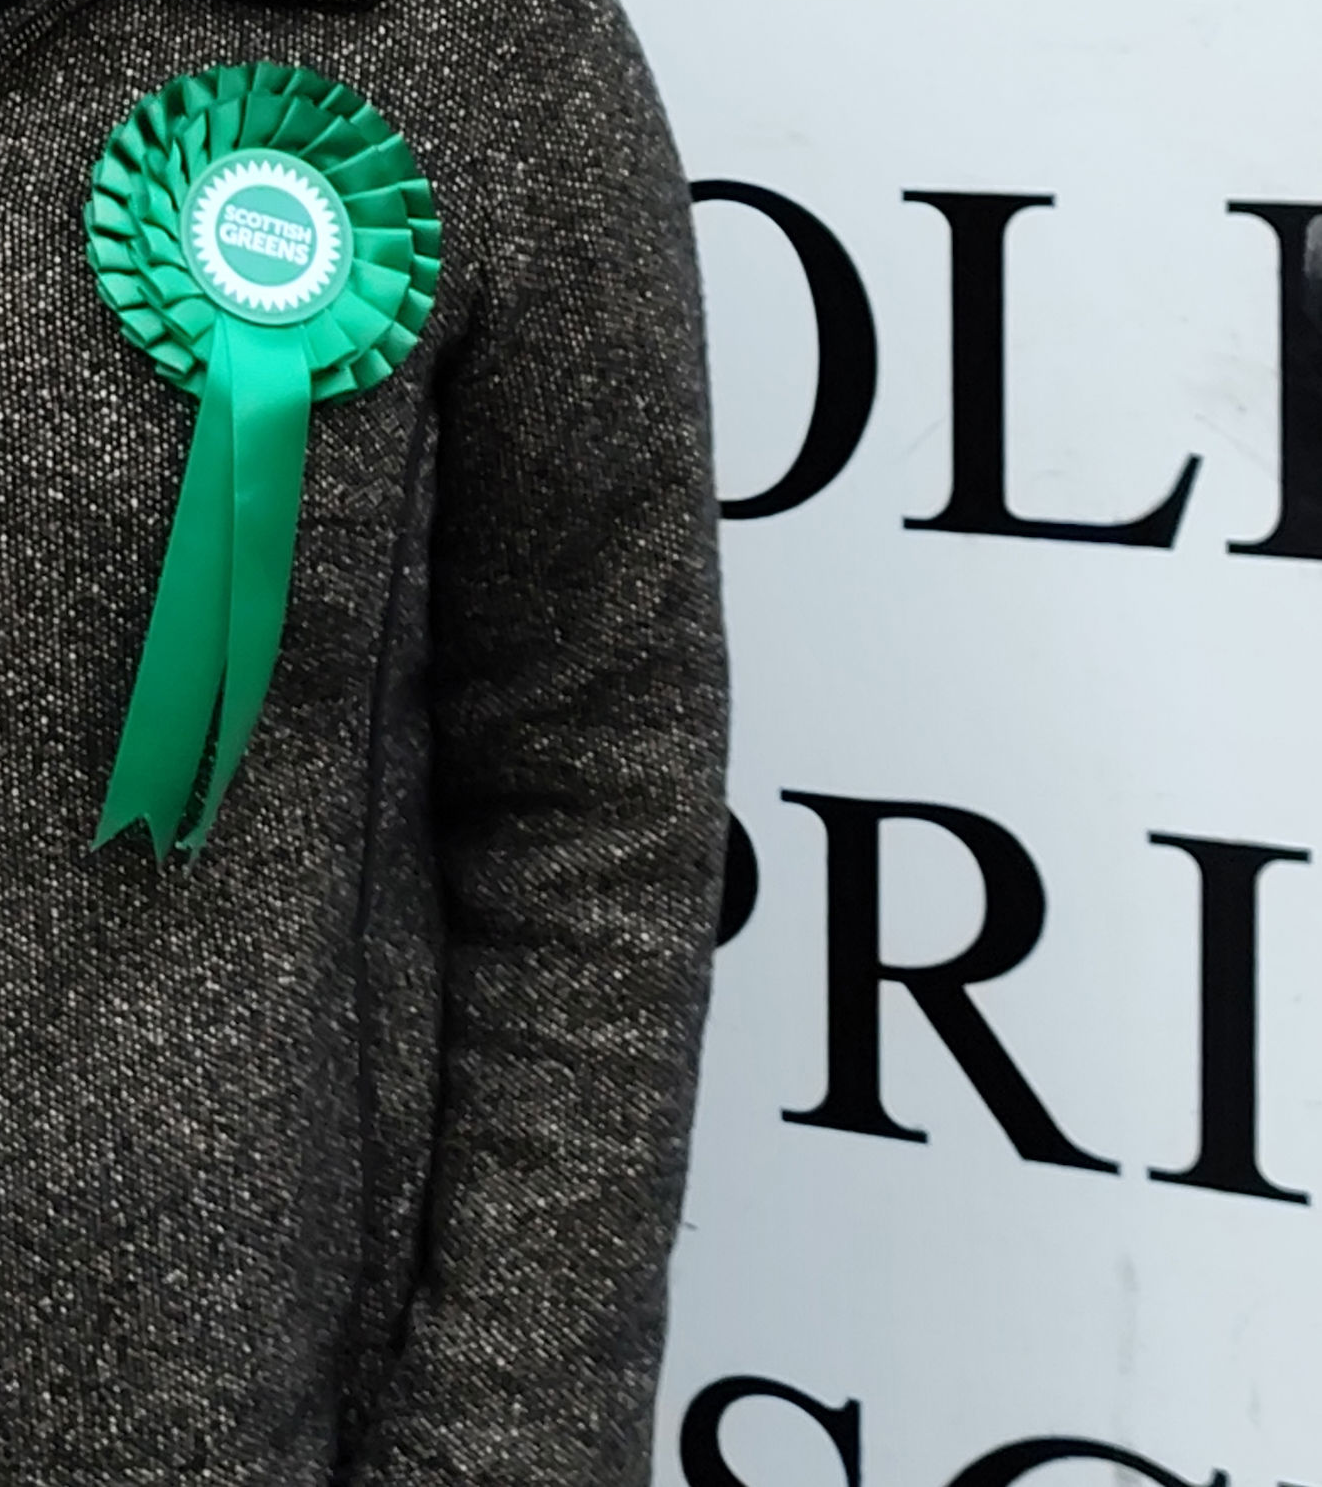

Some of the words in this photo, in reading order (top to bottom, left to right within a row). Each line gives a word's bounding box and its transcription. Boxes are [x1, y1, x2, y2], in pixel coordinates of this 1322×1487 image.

[219, 222, 311, 265] GREENS
[223, 204, 313, 244] SCOTTISH
[715, 788, 1312, 1206] RI
